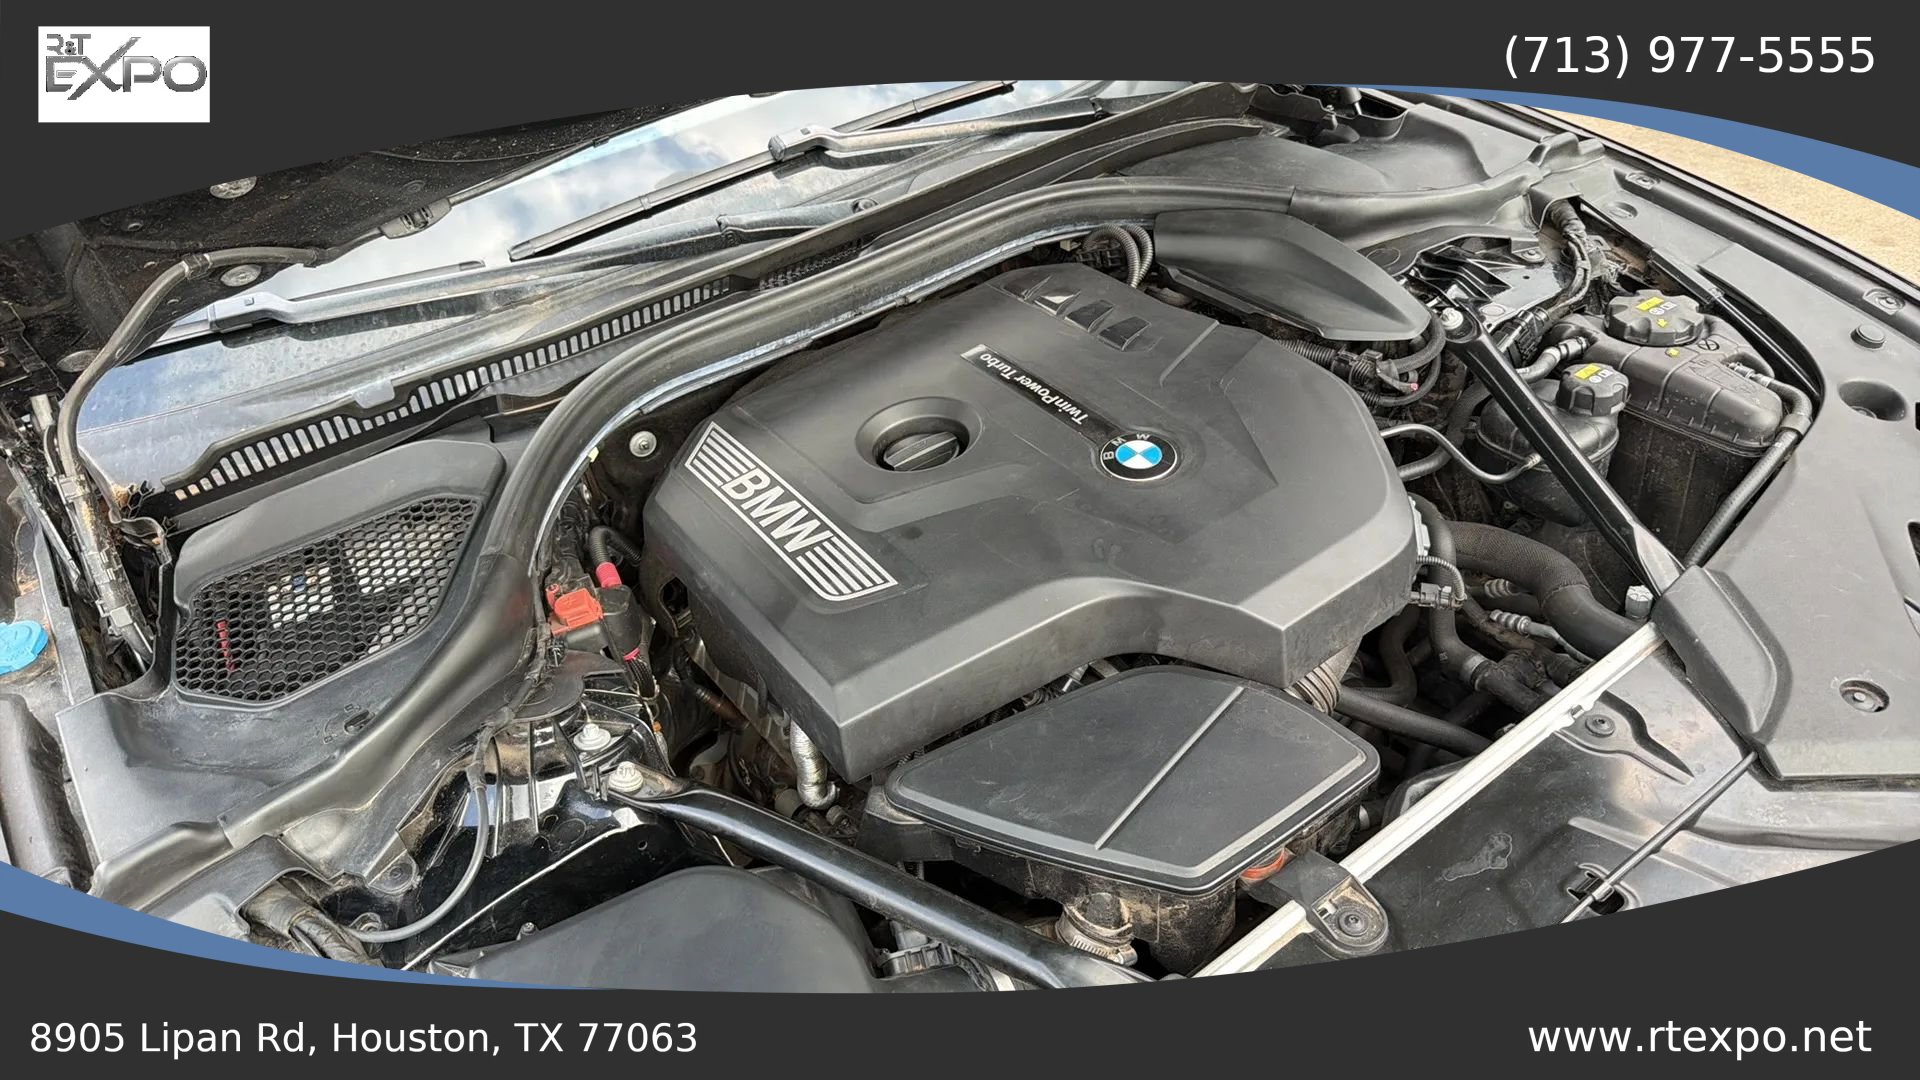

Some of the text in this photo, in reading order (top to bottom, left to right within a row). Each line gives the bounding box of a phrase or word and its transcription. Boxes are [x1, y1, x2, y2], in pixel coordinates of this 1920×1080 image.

[979, 351, 1090, 426] TwinPower Turbo
[1102, 433, 1151, 461] BMW
[720, 466, 835, 553] BMW
